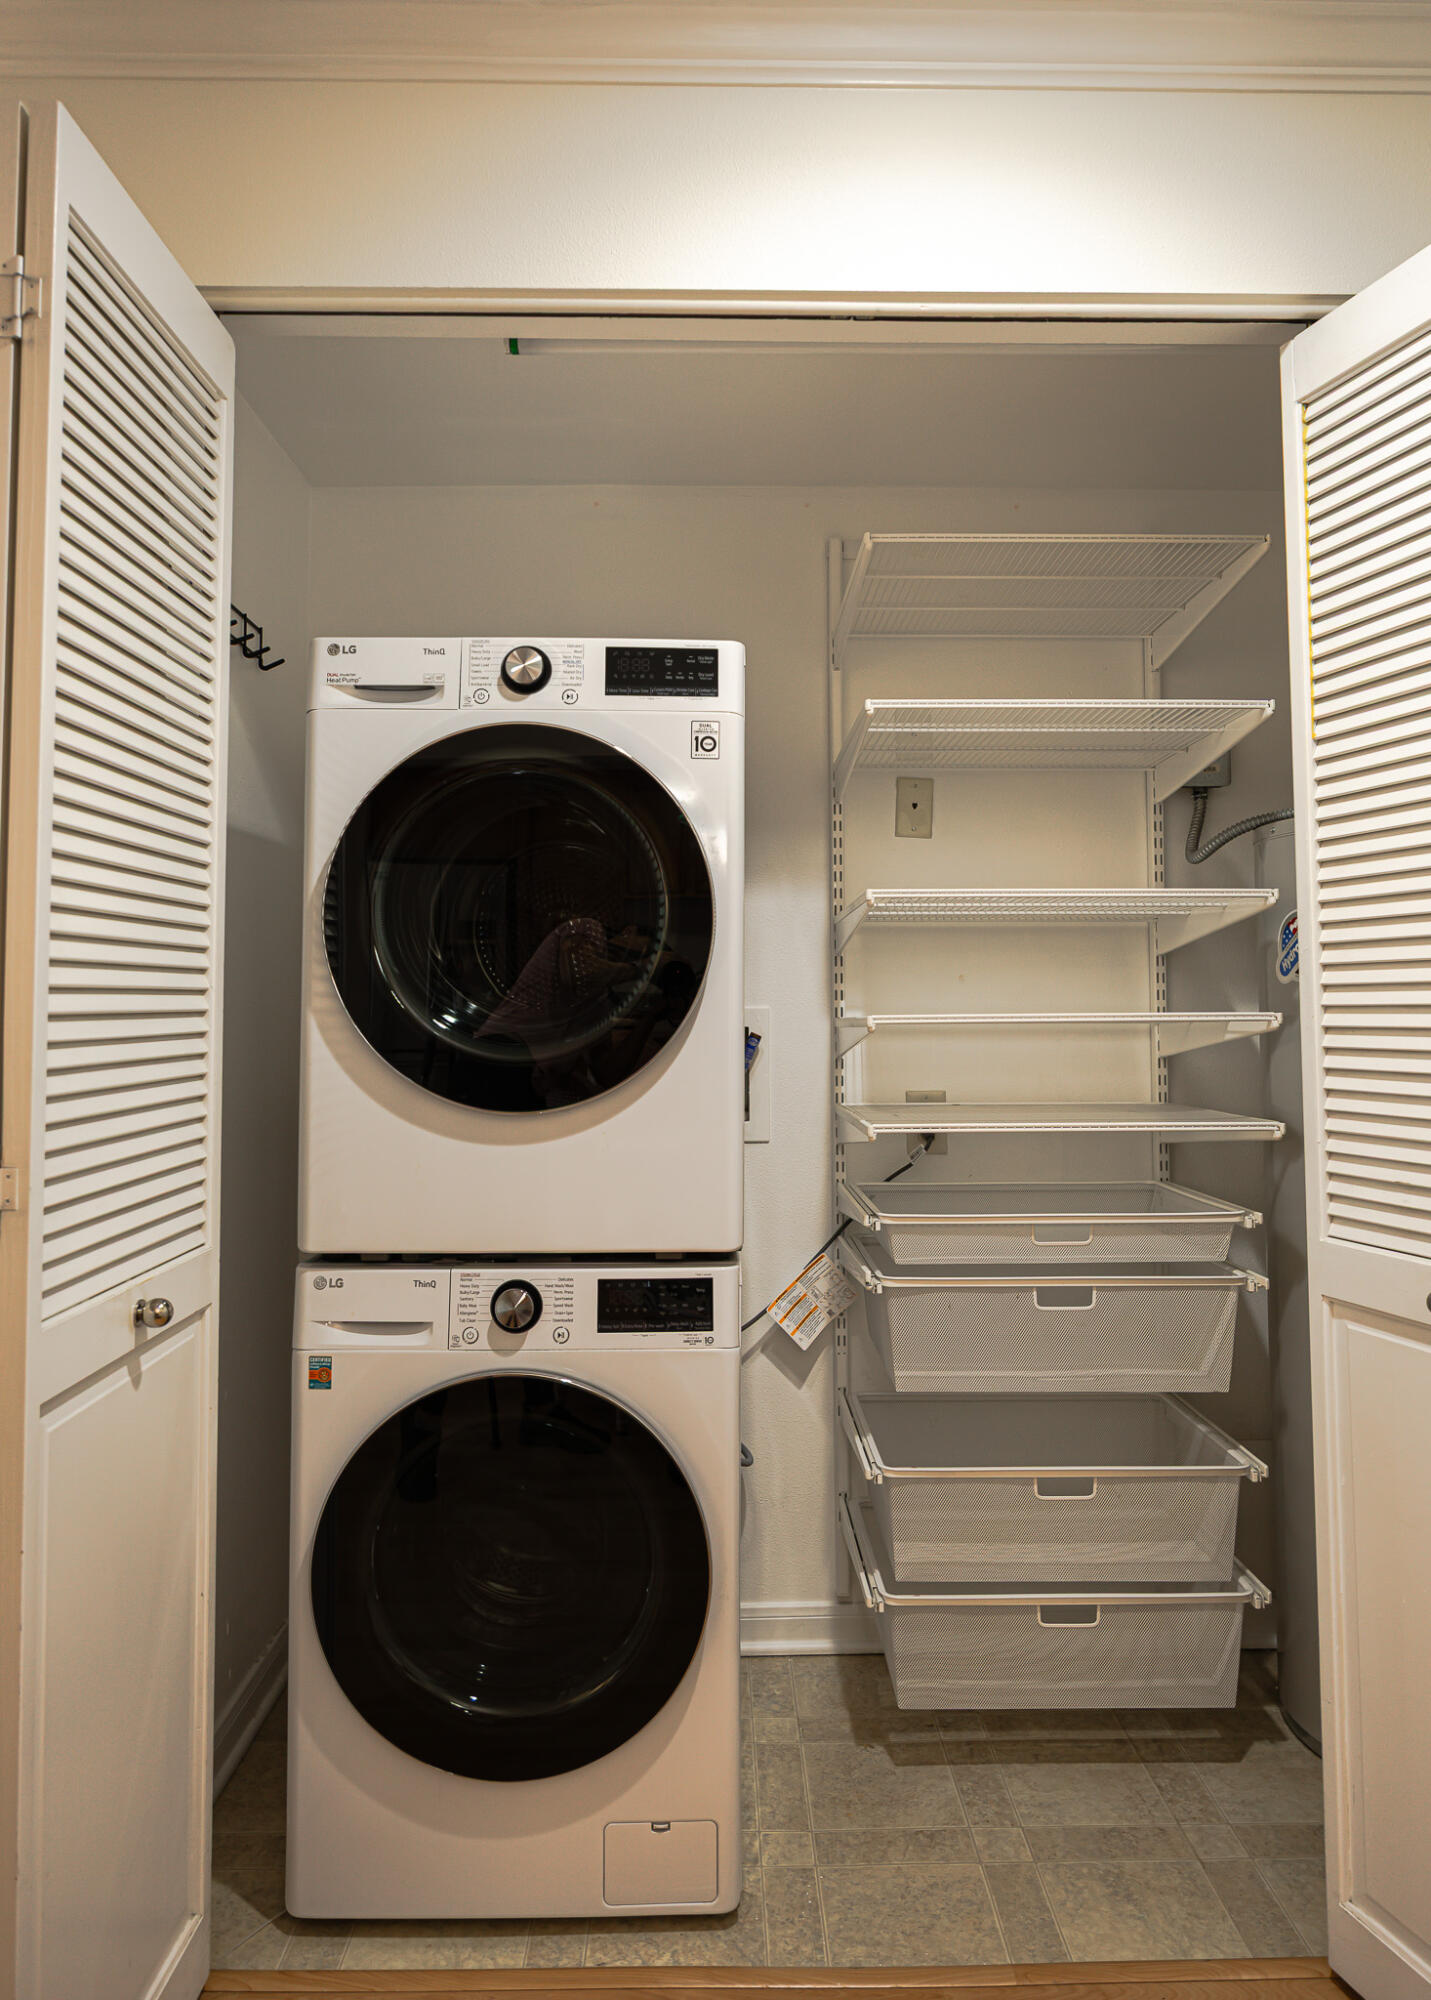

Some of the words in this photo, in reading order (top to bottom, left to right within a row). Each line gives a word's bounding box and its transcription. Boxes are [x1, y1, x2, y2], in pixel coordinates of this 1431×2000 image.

[342, 645, 357, 655] LG
[422, 648, 445, 656] ThinQ
[694, 735, 717, 752] 10
[329, 1278, 344, 1288] LG
[413, 1280, 436, 1288] ThinQ
